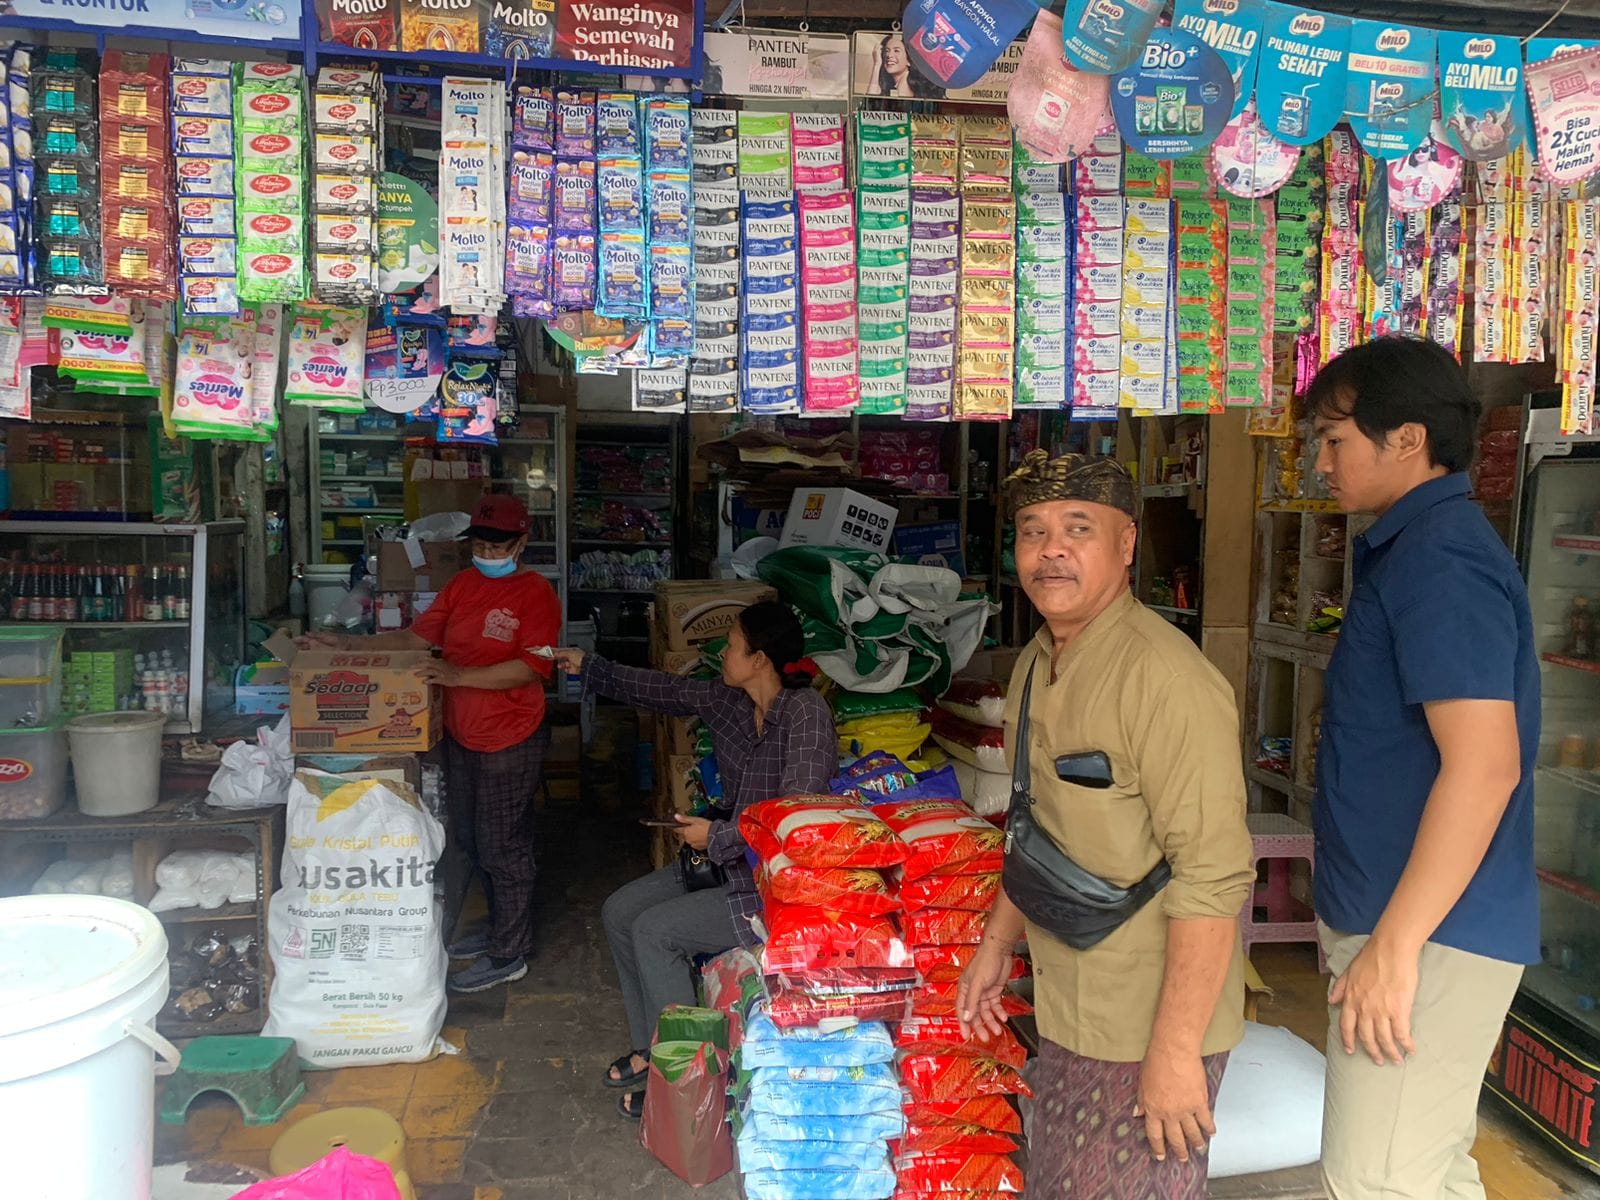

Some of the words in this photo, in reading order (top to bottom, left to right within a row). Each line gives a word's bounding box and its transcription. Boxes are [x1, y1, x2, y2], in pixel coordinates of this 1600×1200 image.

[1098, 3, 1121, 17] MILO
[1207, 0, 1235, 10] MILO
[492, 3, 548, 27] Molto
[570, 3, 679, 29] Wanginya
[1294, 19, 1320, 31] MILO
[574, 27, 675, 51] Semewah
[980, 23, 1000, 46] HALAL
[1178, 15, 1206, 32] AYO
[1202, 19, 1257, 51] MILO
[748, 39, 808, 54] PANTENE
[1380, 35, 1406, 46] MILO
[1267, 36, 1307, 56] PILIHAN
[1310, 44, 1342, 62] LEBIH
[1468, 43, 1494, 53] MILO
[761, 57, 797, 68] RAMBUT
[988, 63, 1019, 73] AMBUT
[1278, 53, 1328, 78] SEHAT
[1354, 59, 1374, 69] BELI
[1375, 60, 1386, 71] 10
[1389, 65, 1421, 75] GRATIS
[1444, 76, 1470, 88] BELI
[1446, 62, 1470, 75] AYO
[1469, 64, 1519, 91] MILO
[749, 84, 772, 93] HINGGA
[774, 85, 782, 93] 2X
[1379, 86, 1401, 96] MILO
[1553, 74, 1584, 96] SELEB
[450, 89, 485, 100] Molto
[972, 90, 992, 98] HINGGA
[255, 99, 286, 107] Lifebuoy
[518, 97, 553, 112] Molto
[600, 106, 633, 118] Molto
[863, 111, 905, 122] PANTENE
[653, 116, 686, 129] Molto
[796, 115, 839, 126] PANTENE
[911, 115, 955, 126] PANTENE
[1566, 116, 1591, 131] Bisa
[255, 139, 286, 148] Lifebuoy
[742, 138, 785, 150] PANTENE
[1550, 130, 1574, 149] 2X
[1575, 128, 1600, 141] Cuci
[1556, 143, 1592, 161] Makin
[1554, 153, 1595, 172] Hemat
[514, 165, 549, 181] Molto
[1128, 167, 1155, 175] Rejoice
[255, 180, 286, 188] Lifebuoy
[558, 176, 592, 190] Molto
[603, 175, 637, 188] Molto
[693, 192, 737, 203] PANTENE
[1280, 199, 1309, 208] Rejoice
[914, 206, 956, 218] PANTENE
[965, 207, 1011, 219] PANTENE
[806, 213, 850, 225] PANTENE
[1584, 205, 1595, 240] Downy
[451, 233, 485, 245] Molto
[1232, 236, 1260, 246] Rejoice
[510, 240, 545, 256] Molto
[557, 251, 591, 264] Molto
[606, 250, 640, 263] Molto
[653, 262, 687, 275] Molto
[1340, 254, 1350, 291] Downy
[1485, 257, 1496, 293] Downy
[1584, 265, 1595, 301] Downy
[1383, 277, 1394, 314] Downy
[750, 298, 793, 309] PANTENE
[47, 308, 78, 319] 2000
[1231, 308, 1258, 317] Rejoice
[1529, 313, 1540, 348] Downy
[1580, 326, 1592, 361] Downy
[62, 359, 94, 369] 2000
[301, 361, 348, 378] Merries
[811, 361, 854, 373] PANTENE
[641, 374, 683, 386] PANTENE
[751, 372, 794, 383] PANTENE
[189, 380, 244, 399] Merries
[692, 379, 735, 391] PANTENE
[860, 381, 902, 392] PANTENE
[907, 388, 948, 399] PANTENE
[965, 386, 1008, 399] PANTENE
[1578, 386, 1589, 421] Downy
[691, 613, 737, 635] MINYA
[304, 681, 379, 696] Sedaap
[322, 836, 372, 851] Kristal
[380, 833, 420, 848] Putih
[287, 905, 340, 918] Perkebunan
[345, 906, 394, 917] Nusantara
[398, 906, 428, 917] Group
[310, 932, 336, 950] SNI
[323, 993, 346, 1002] Berat
[349, 992, 376, 1001] Bersih
[379, 992, 390, 1001] 50
[392, 993, 404, 1003] kg
[313, 1048, 352, 1058] JANGAN
[353, 1047, 381, 1058] PAKAI
[381, 1045, 413, 1055] GANCU
[1505, 1042, 1595, 1148] ULTIMATE
